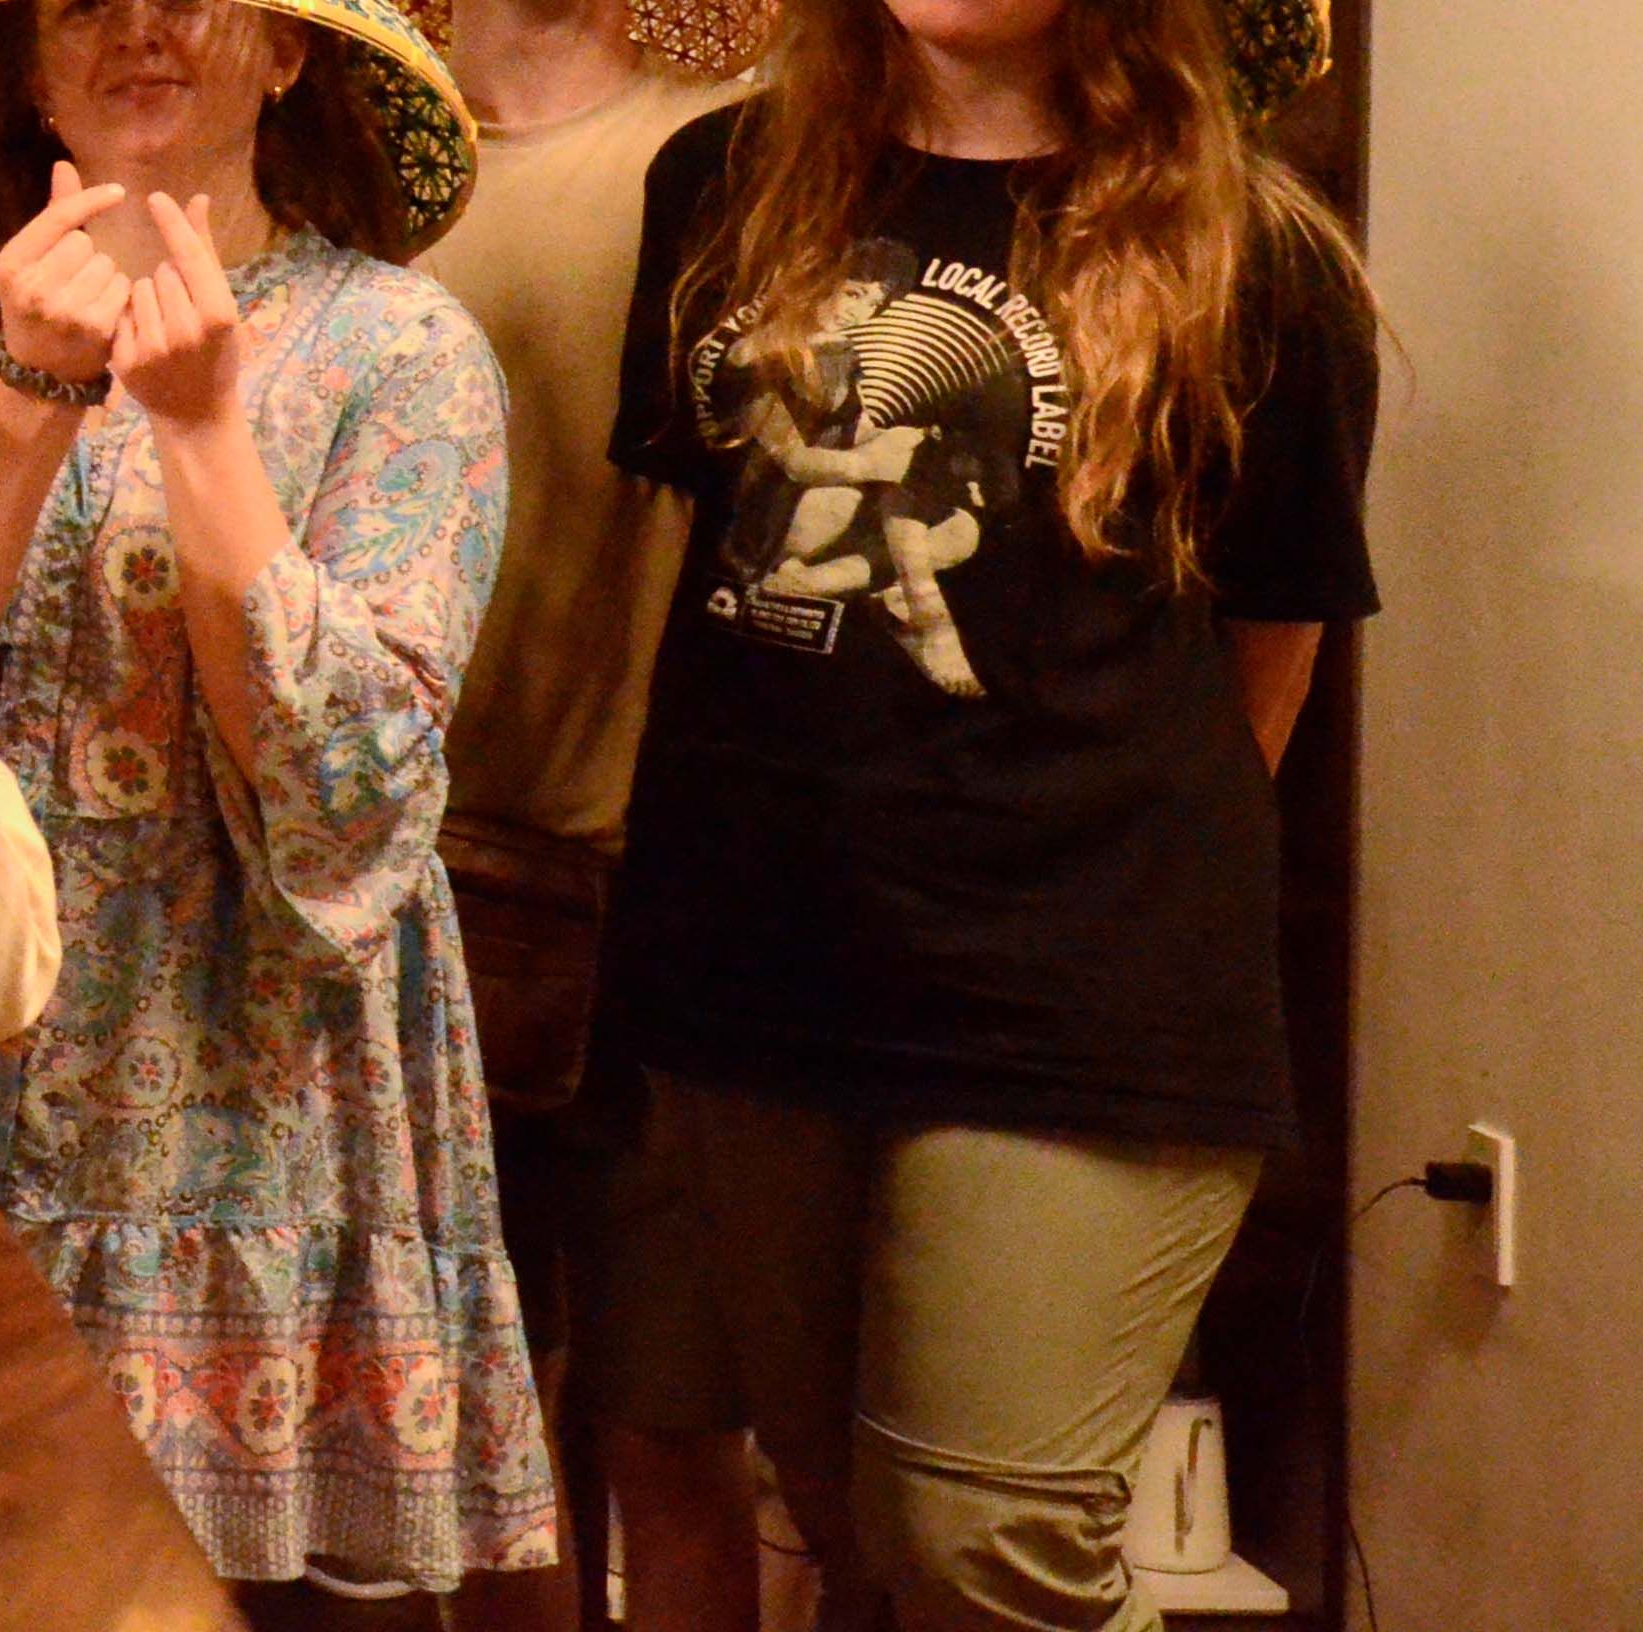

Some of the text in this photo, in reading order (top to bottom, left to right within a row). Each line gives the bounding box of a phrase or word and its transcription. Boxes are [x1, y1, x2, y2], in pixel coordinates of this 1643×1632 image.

[921, 258, 1007, 310] LOCAL
[994, 293, 1062, 378] RECORD
[1024, 385, 1069, 468] LABEL
